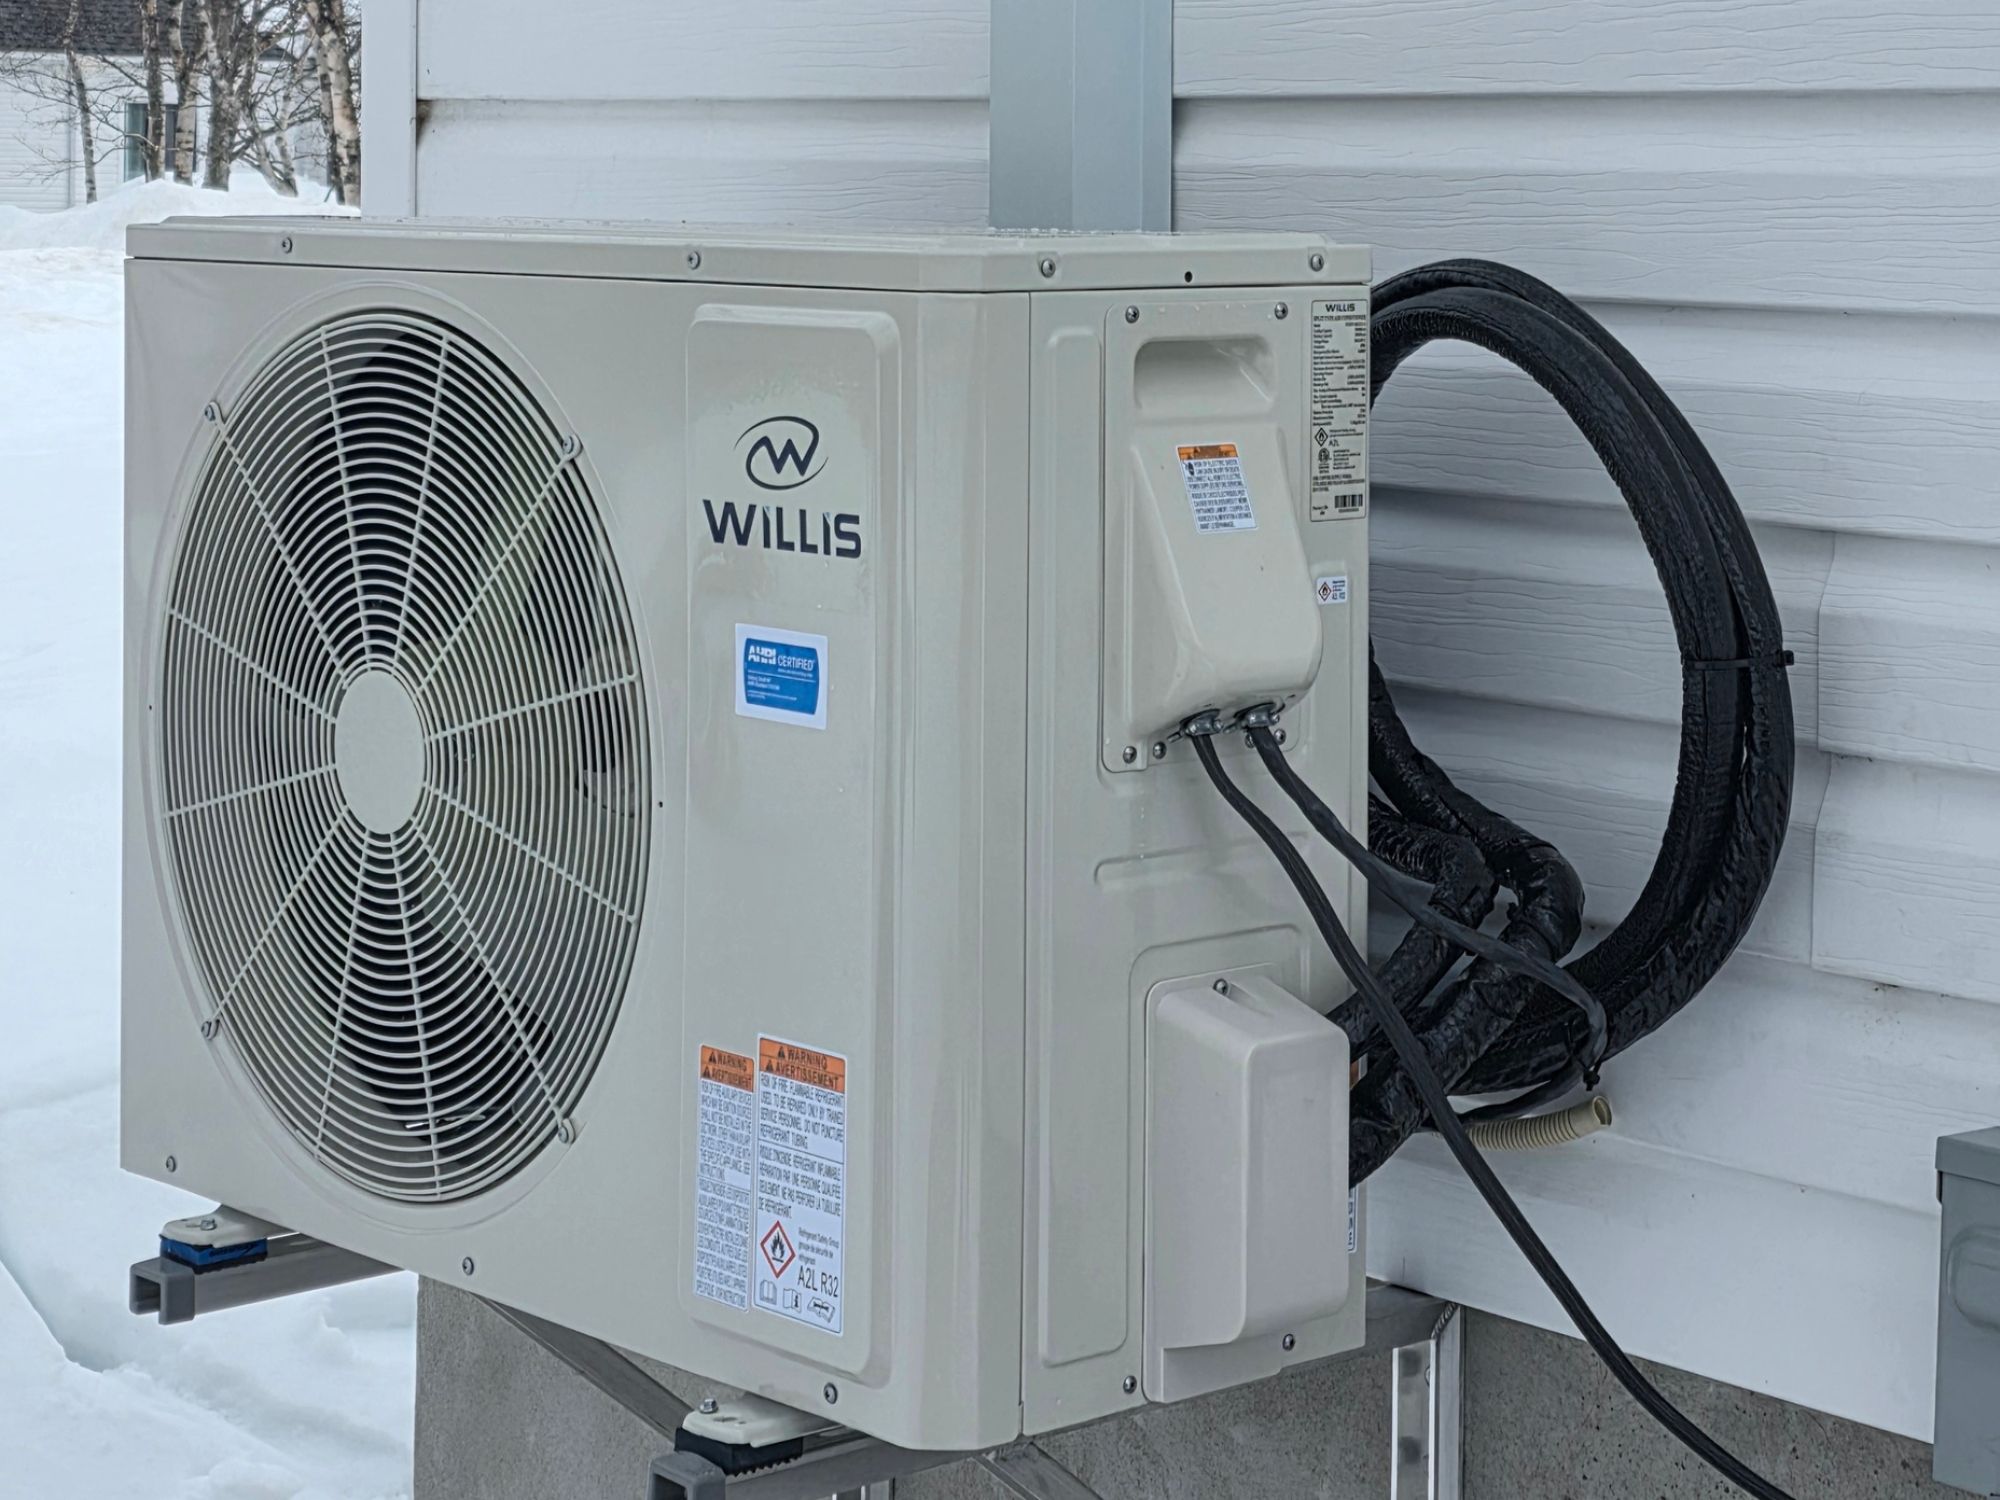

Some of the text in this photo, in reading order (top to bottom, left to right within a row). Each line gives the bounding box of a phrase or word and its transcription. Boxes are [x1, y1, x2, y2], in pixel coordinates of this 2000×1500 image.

[1325, 303, 1355, 312] WILLIS
[703, 499, 861, 559] WILLIS
[788, 1049, 827, 1071] WARNING
[776, 1062, 839, 1089] AVERTISSEMENT
[797, 1265, 839, 1298] A2L R32
